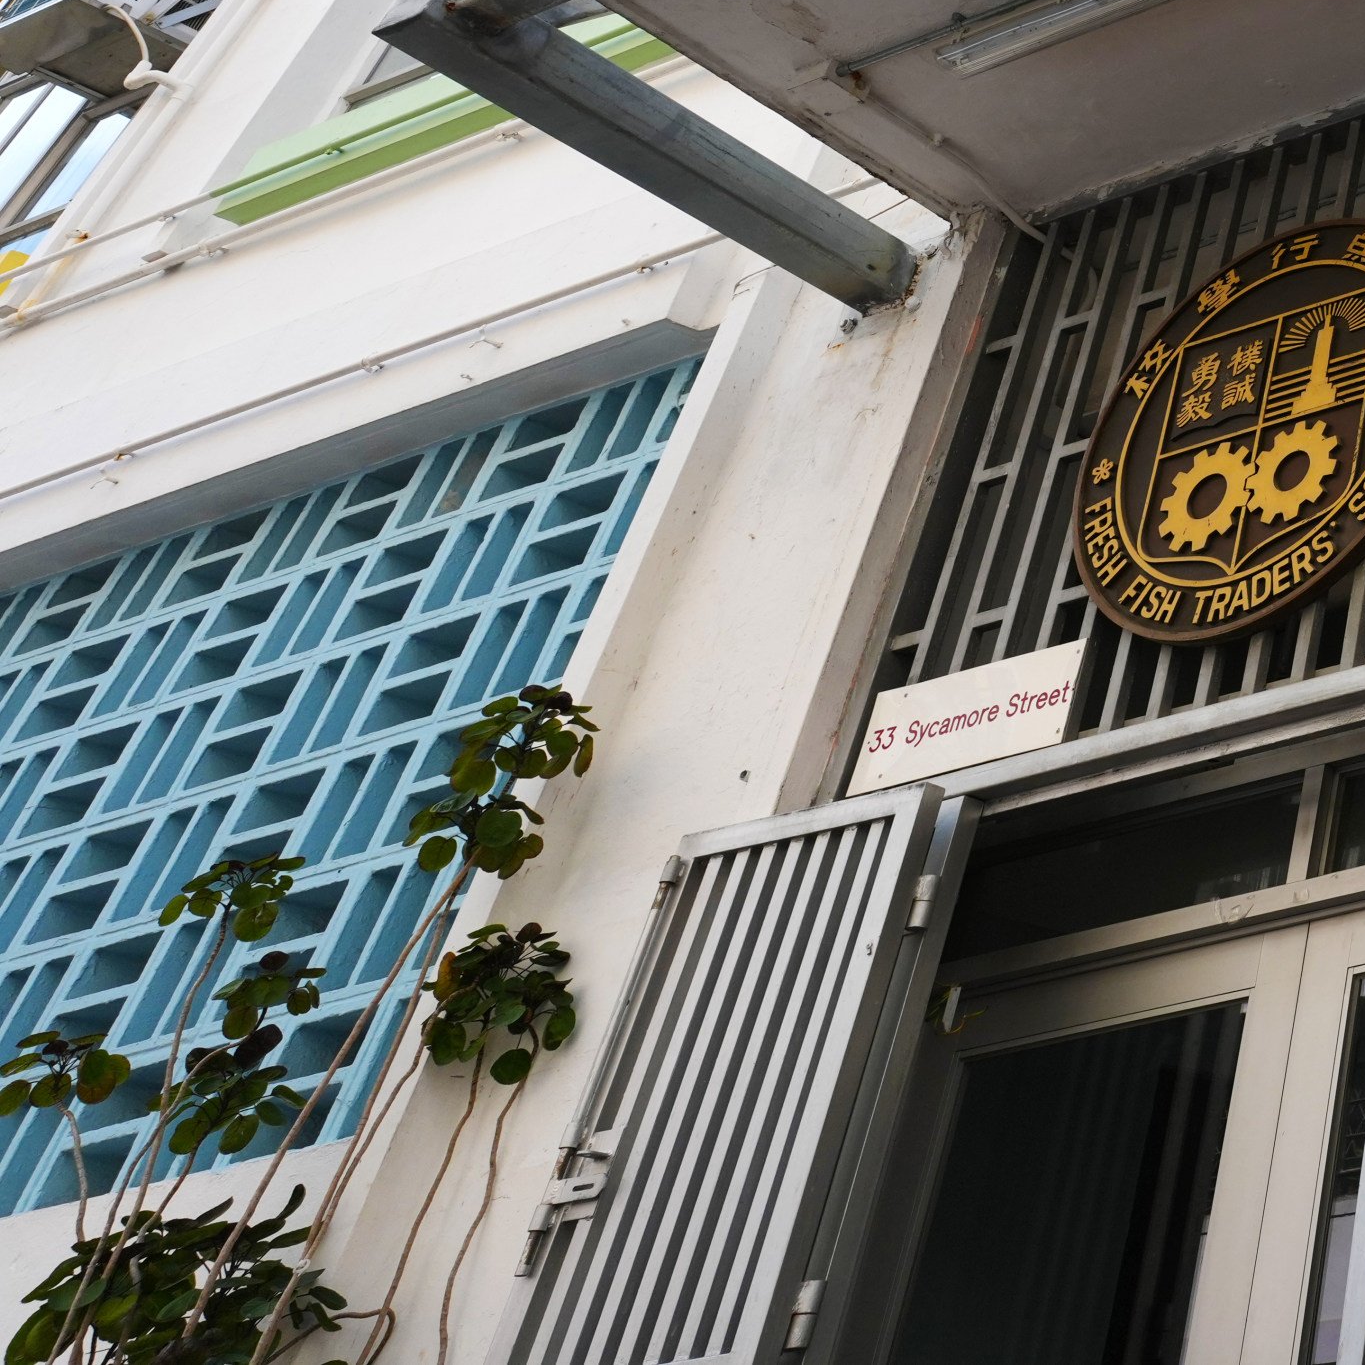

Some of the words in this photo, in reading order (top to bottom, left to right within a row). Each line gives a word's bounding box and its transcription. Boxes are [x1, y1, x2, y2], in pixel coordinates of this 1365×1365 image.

[1084, 496, 1128, 587] FRESH
[1119, 575, 1186, 624] FISH
[868, 725, 897, 753] 33
[905, 704, 1000, 748] Sycamore
[1006, 680, 1070, 718] Street
